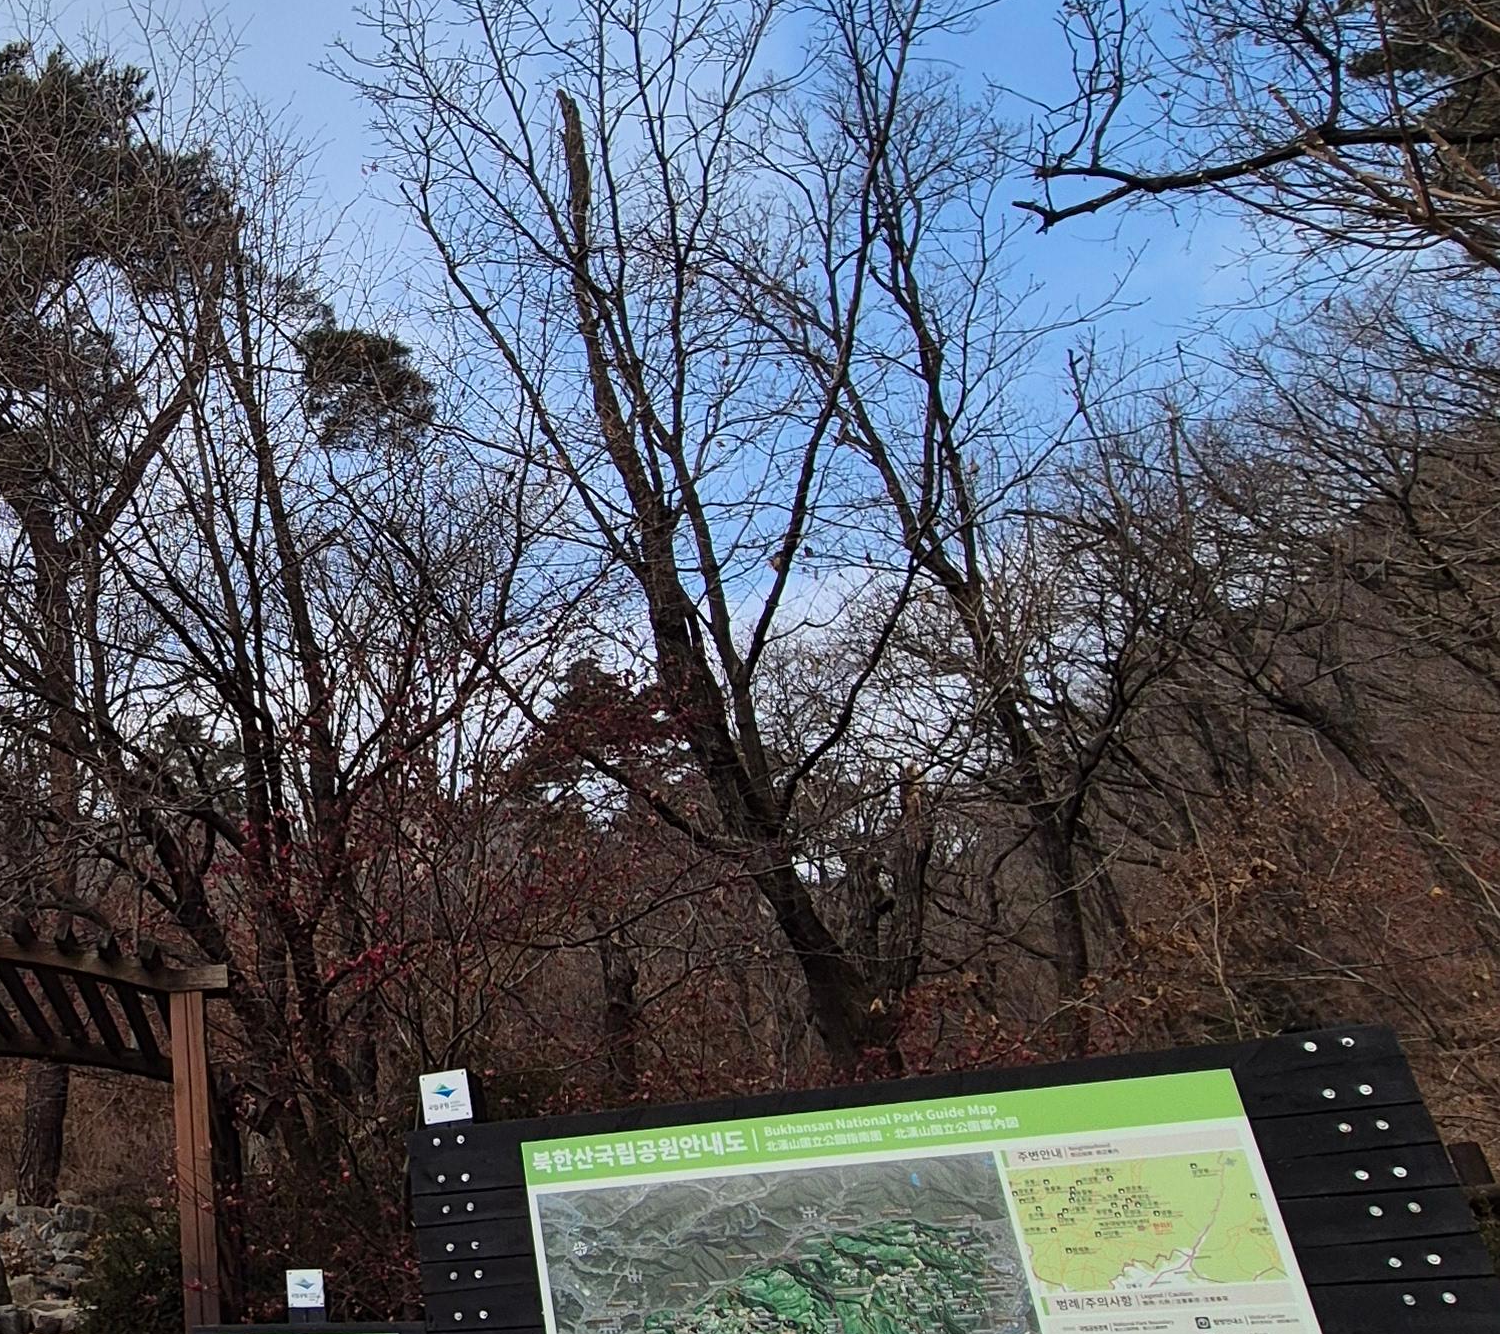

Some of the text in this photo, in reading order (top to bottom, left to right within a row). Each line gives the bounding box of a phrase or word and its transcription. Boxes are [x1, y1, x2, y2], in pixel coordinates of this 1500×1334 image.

[764, 1103, 998, 1137] Bukhansan National Park Guide Map
[532, 1130, 748, 1174] 북한산국립공원안내도
[1017, 1148, 1064, 1162] 주변안내
[1056, 1295, 1133, 1311] 범례/주의사항
